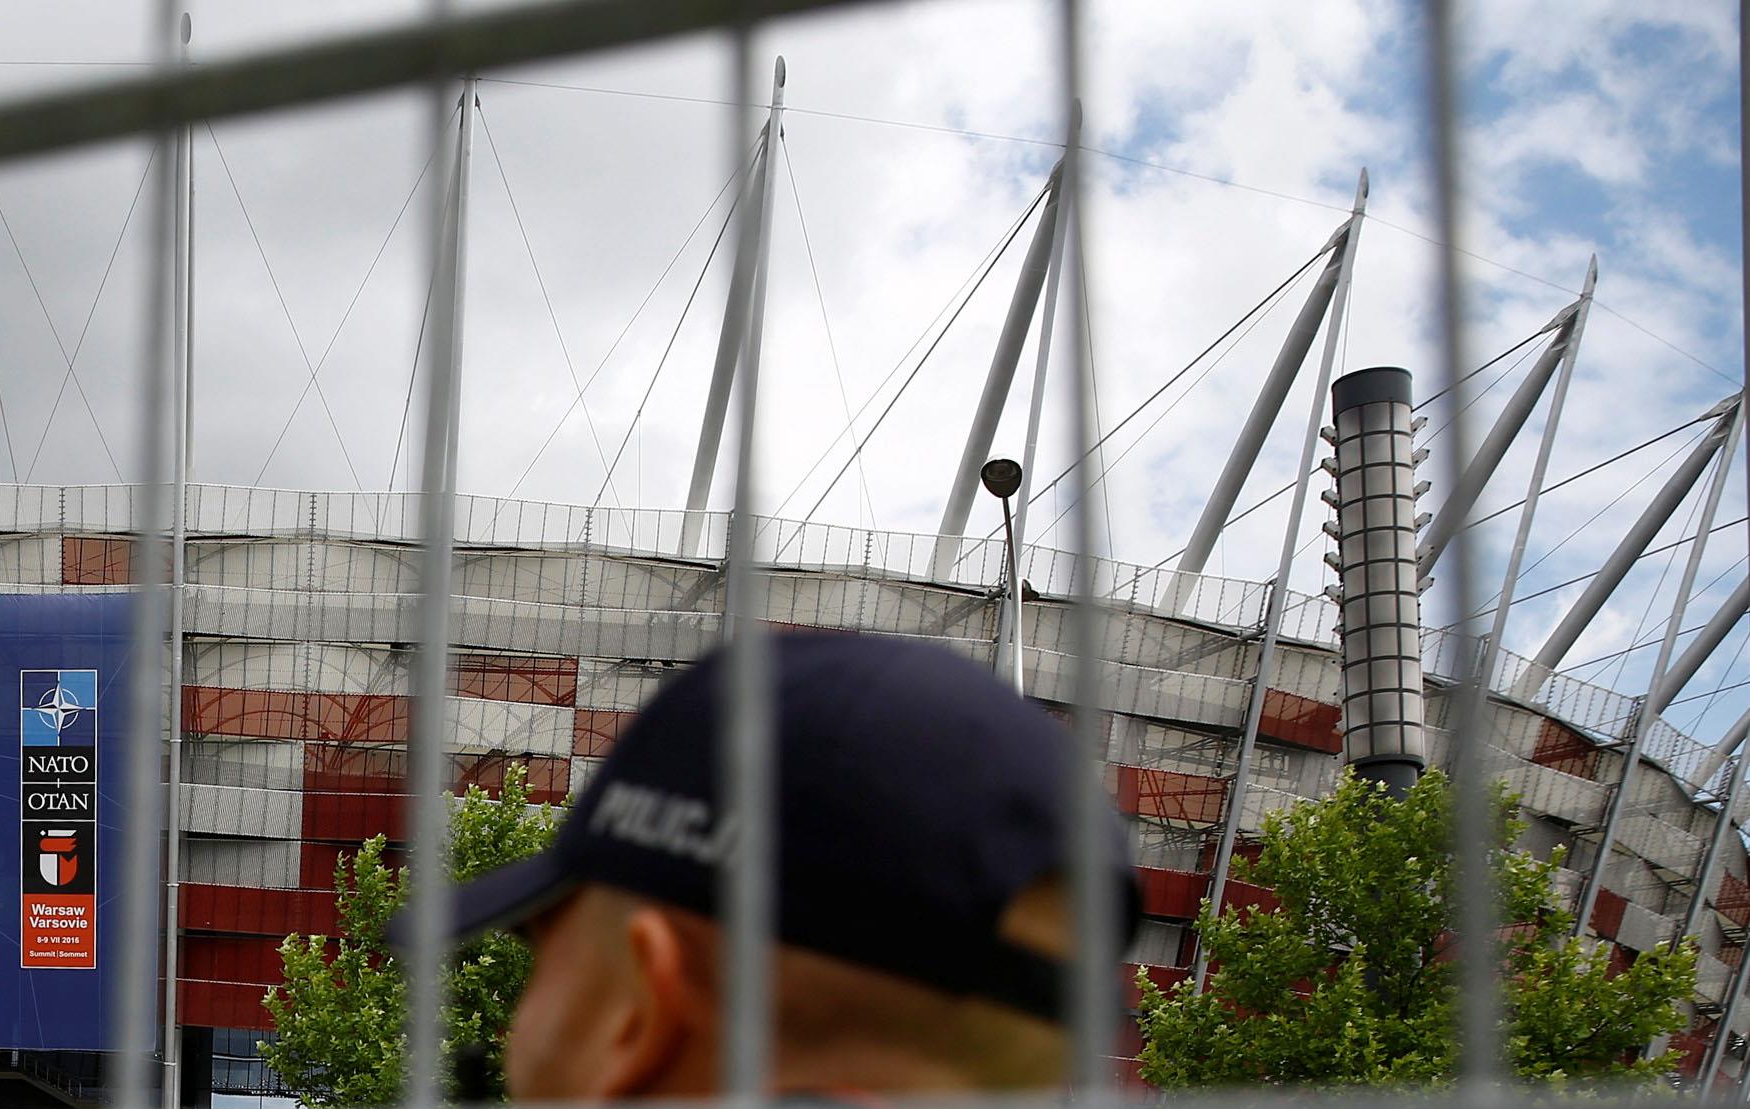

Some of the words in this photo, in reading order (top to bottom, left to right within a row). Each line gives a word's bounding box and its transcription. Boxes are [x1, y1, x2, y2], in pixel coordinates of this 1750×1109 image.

[28, 755, 89, 774] NATO
[28, 792, 90, 811] OTAN
[31, 903, 86, 916] Warsaw
[29, 916, 88, 929] Varsovie
[37, 936, 49, 944] 8-9
[50, 936, 61, 944] VII
[61, 936, 81, 944] 2016
[59, 950, 88, 958] Sommet
